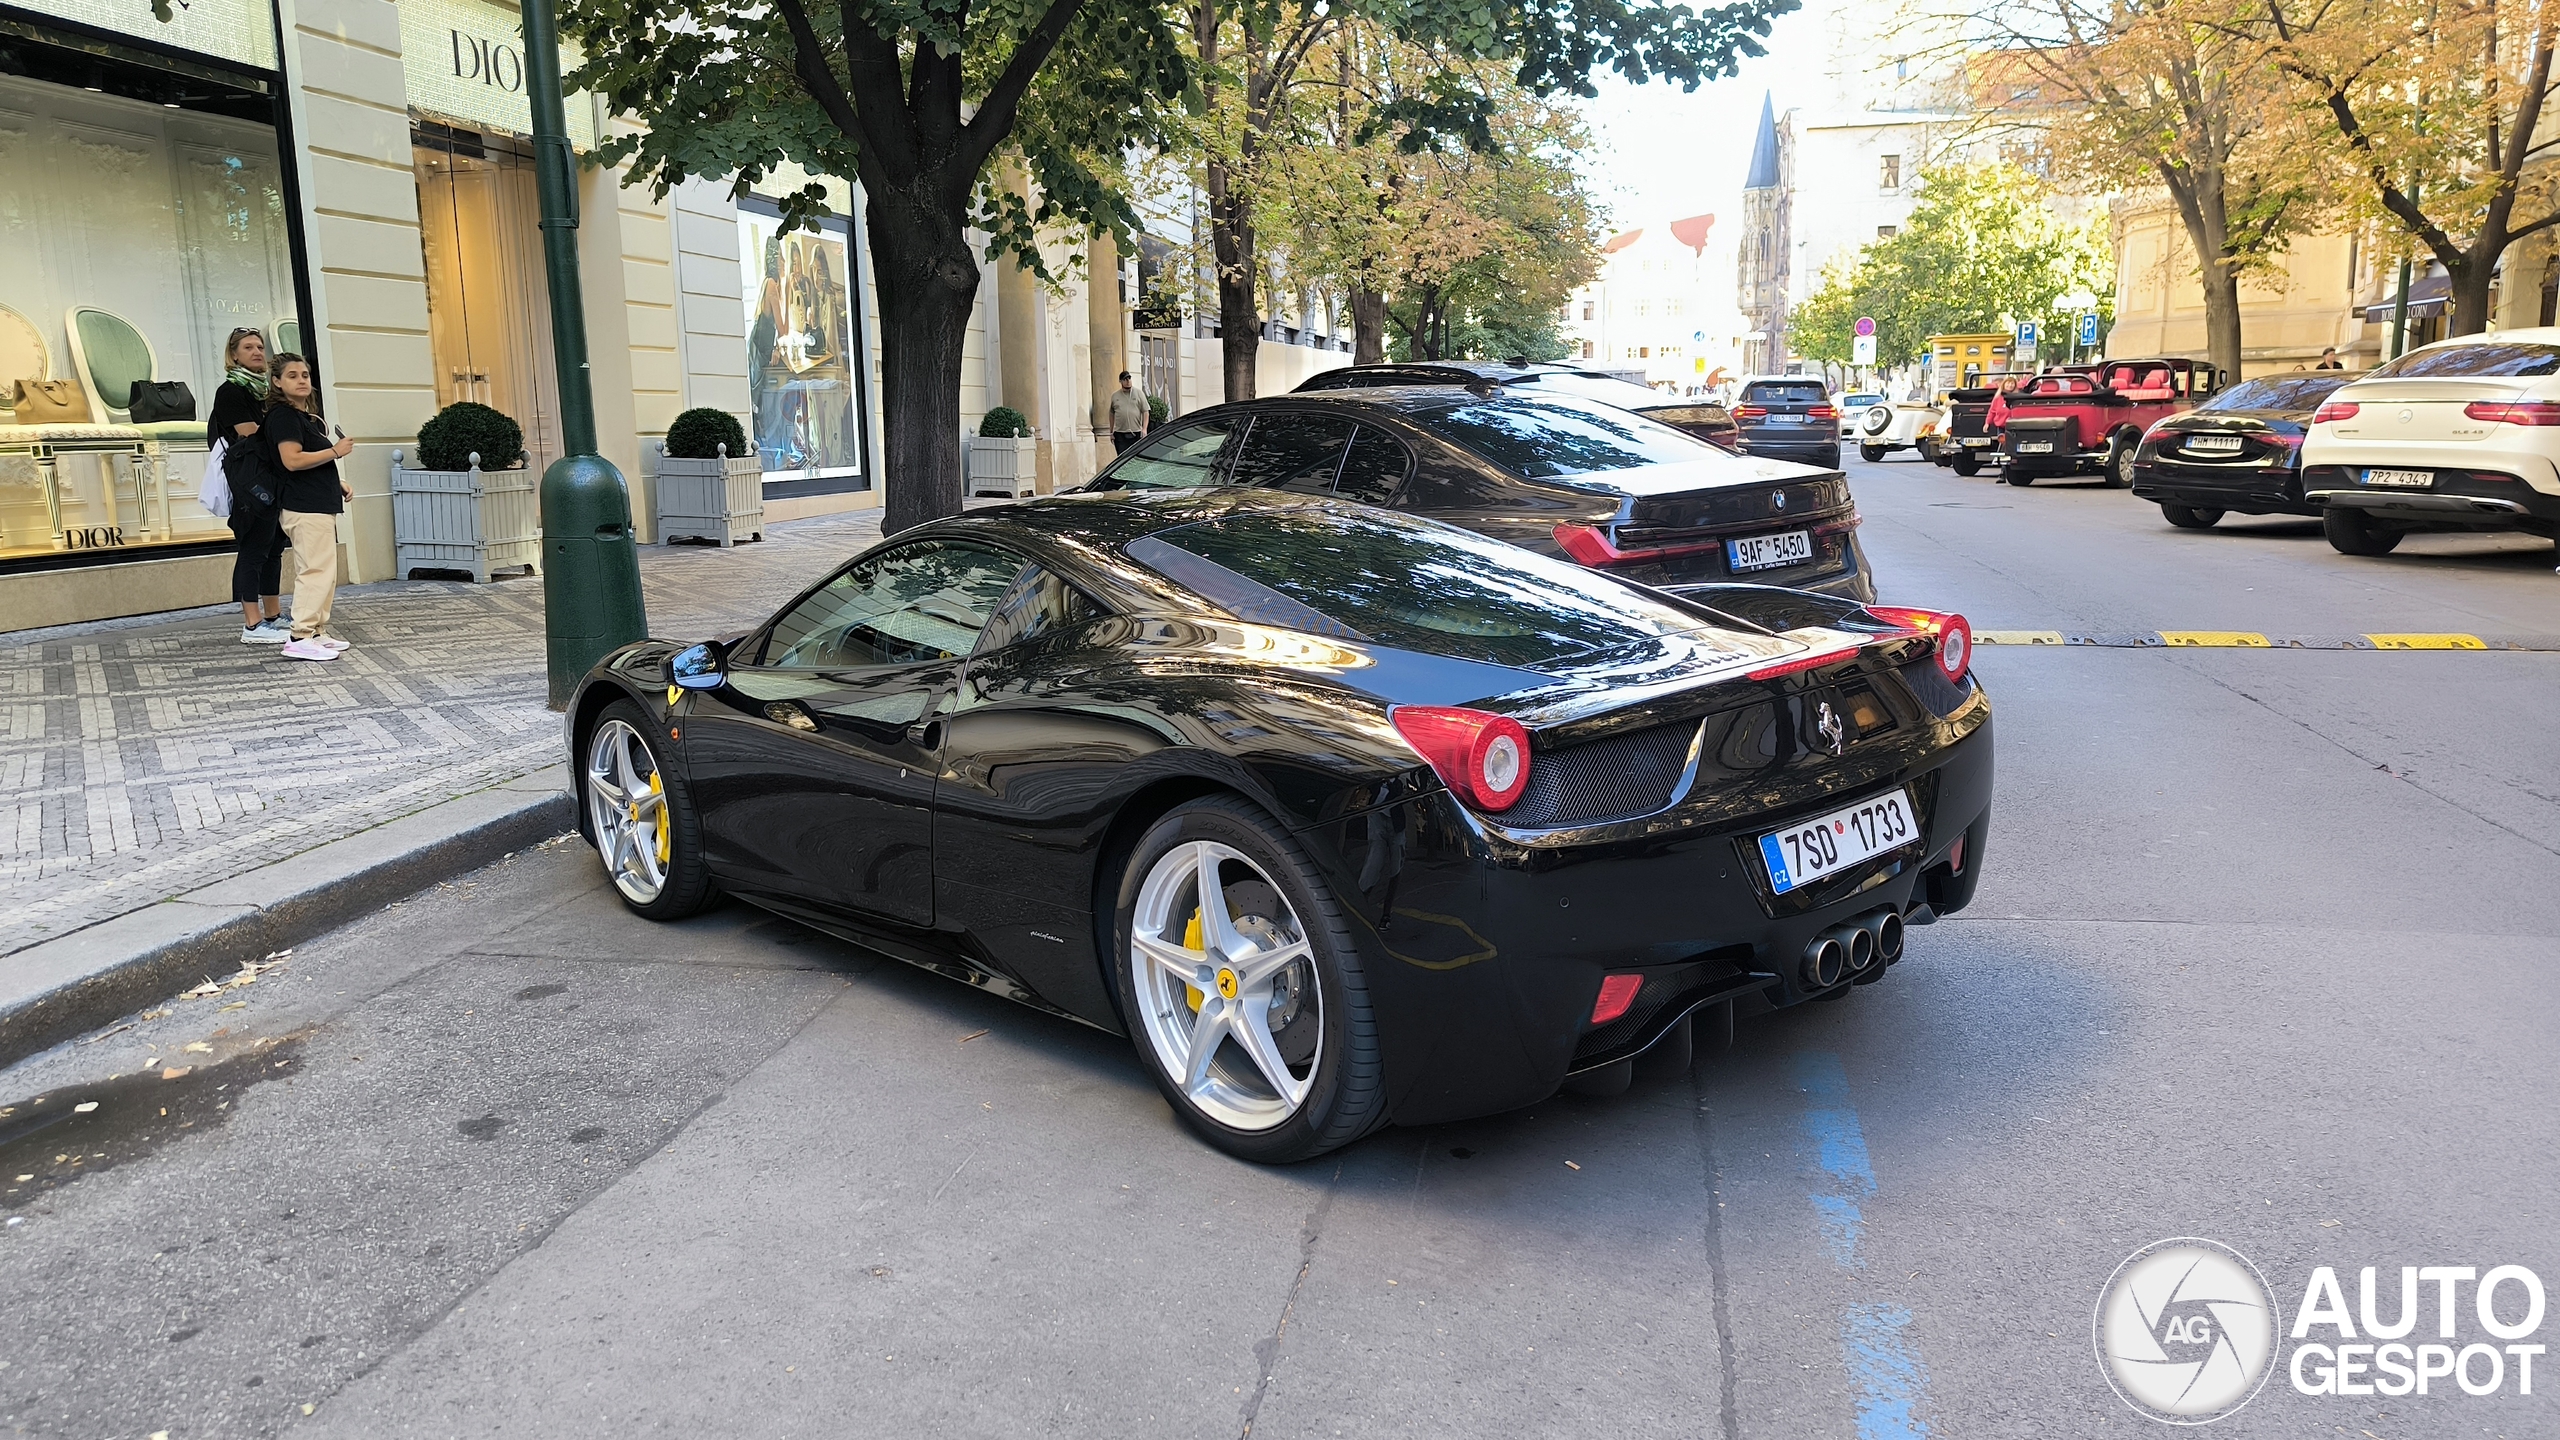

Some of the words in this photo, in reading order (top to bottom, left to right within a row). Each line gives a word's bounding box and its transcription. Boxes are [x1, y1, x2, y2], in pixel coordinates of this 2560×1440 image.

[448, 28, 529, 96] DIO
[2411, 304, 2428, 318] COIN
[2021, 323, 2032, 339] P
[2084, 317, 2094, 336] P
[2213, 437, 2240, 448] 11111
[2370, 470, 2391, 483] 7P2
[2399, 472, 2428, 486] 4343
[65, 526, 126, 550] DIOR
[1740, 539, 1763, 564] 9AF
[1772, 534, 1805, 559] 5450
[1774, 869, 1788, 885] CZ
[1784, 824, 1838, 878] 7SD
[1850, 798, 1906, 852] 1733
